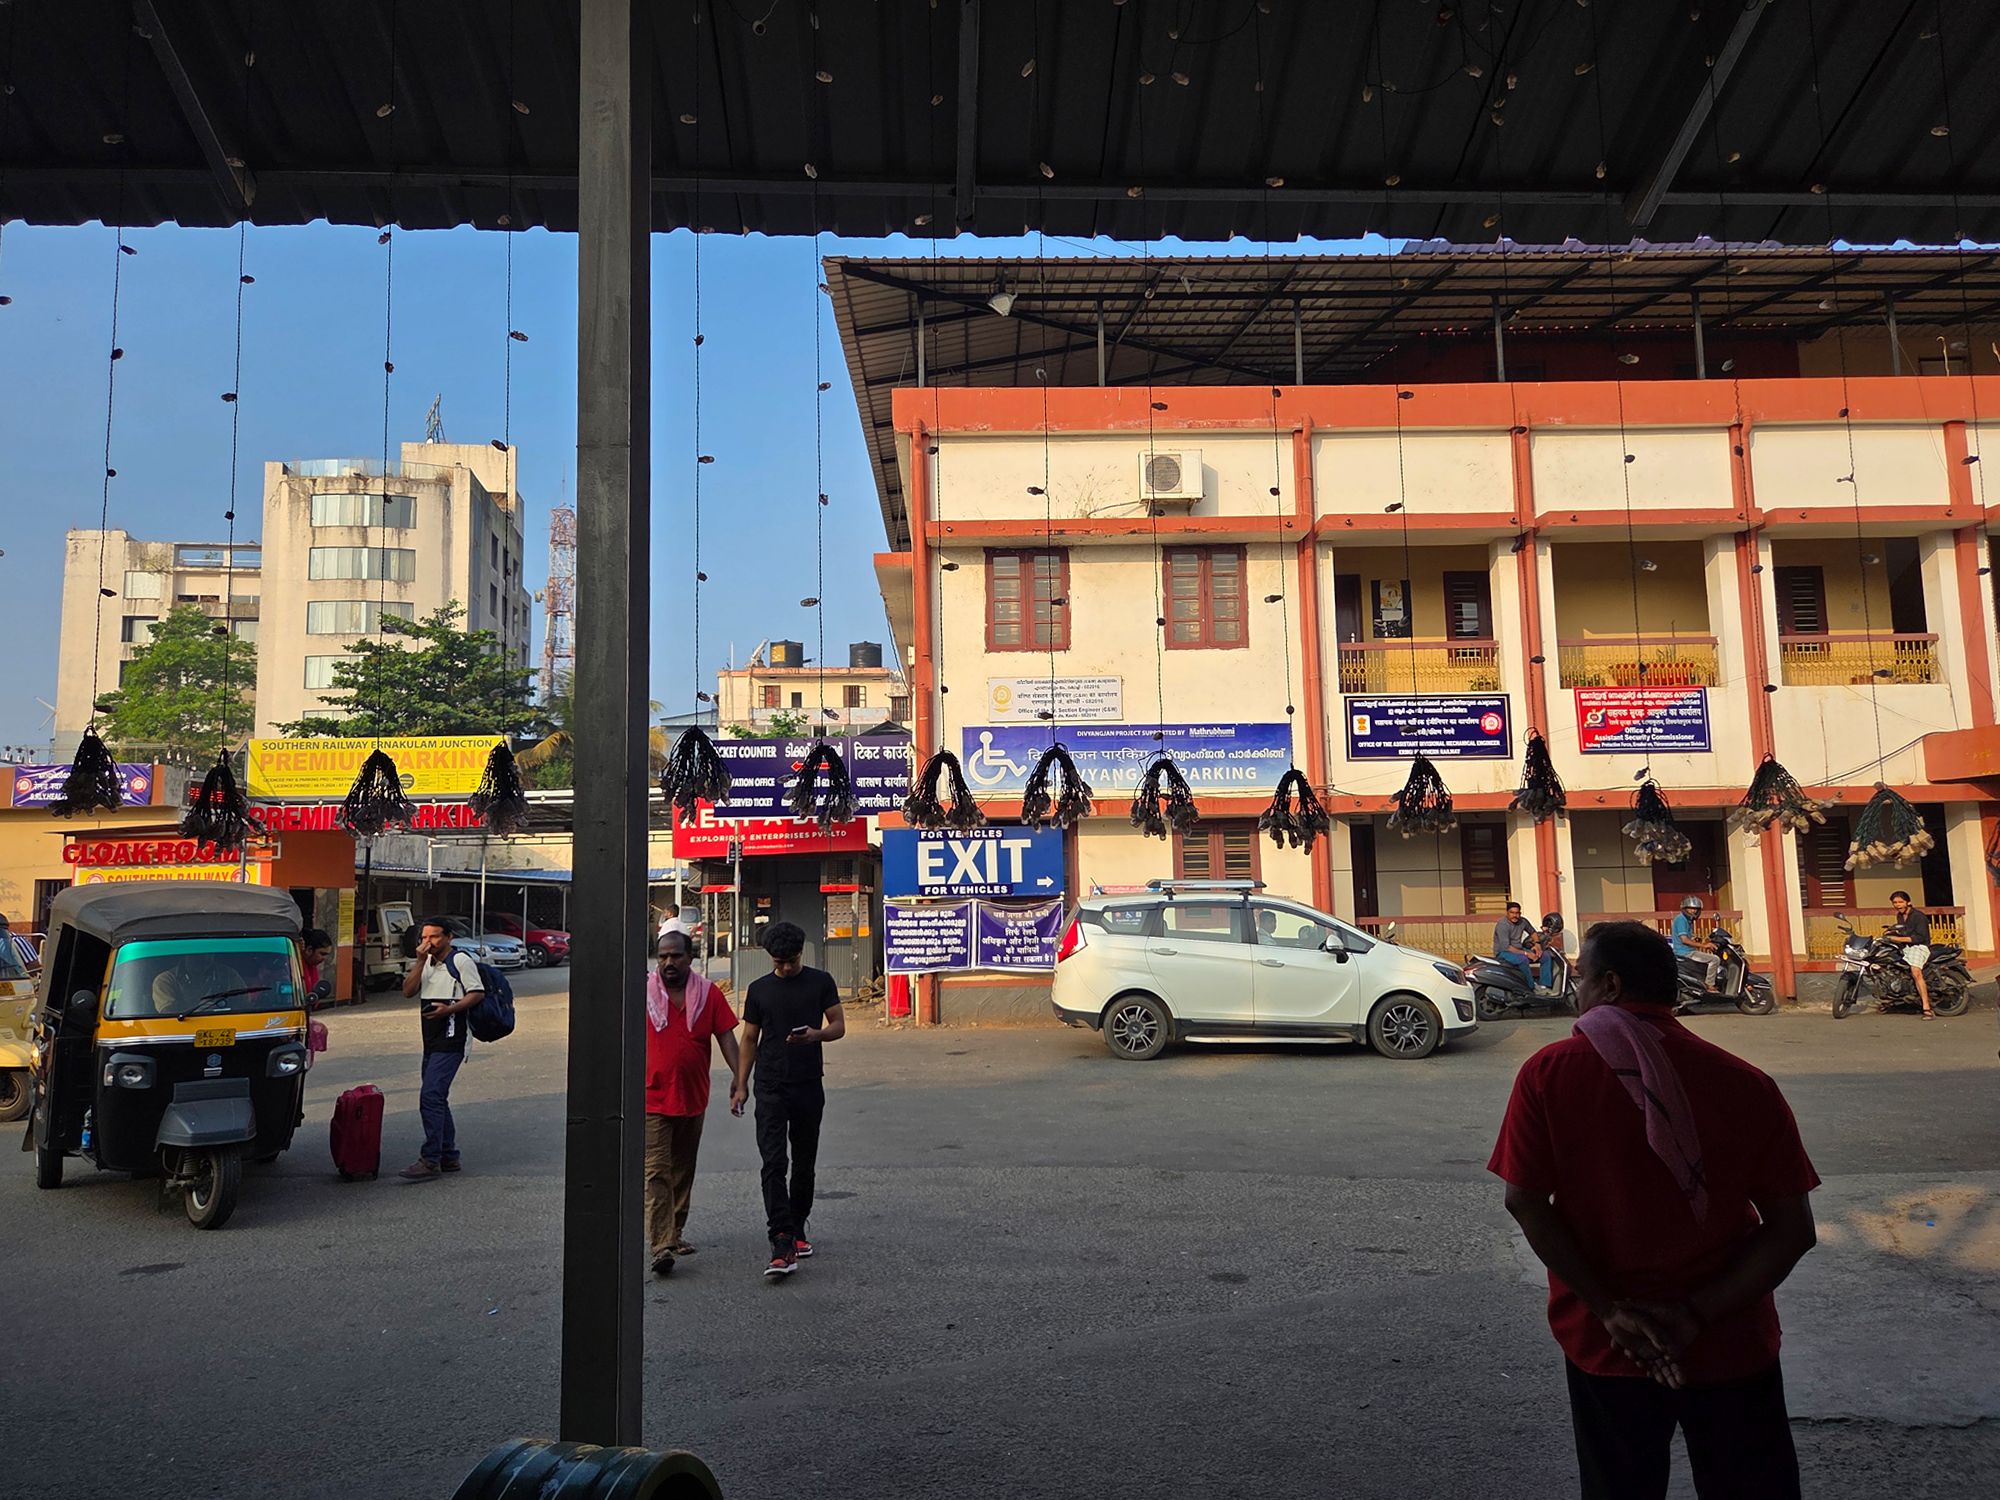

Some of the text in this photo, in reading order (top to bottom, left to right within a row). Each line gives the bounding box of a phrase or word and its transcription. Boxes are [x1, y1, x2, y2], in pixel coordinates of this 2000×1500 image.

[1679, 706, 1701, 716] कार्यालय
[1189, 728, 1235, 736] Mathrubhumi
[262, 739, 493, 750] SOUTHERN RAILWAY ERNAKULAM JUNCTION
[717, 746, 778, 759] CKET COUNTER
[854, 741, 881, 761] टिकट
[1182, 766, 1258, 781] PARKING
[731, 778, 754, 786] VATION
[755, 778, 775, 786] OFFICE
[856, 774, 908, 788] आरक्षण कार्याल
[754, 798, 773, 806] TICKET
[249, 805, 343, 831] PREMI
[750, 832, 809, 840] ENTERPRISES
[62, 841, 153, 864] CLOAK
[917, 839, 1032, 886] EXIT
[952, 886, 1007, 894] VEHICLES
